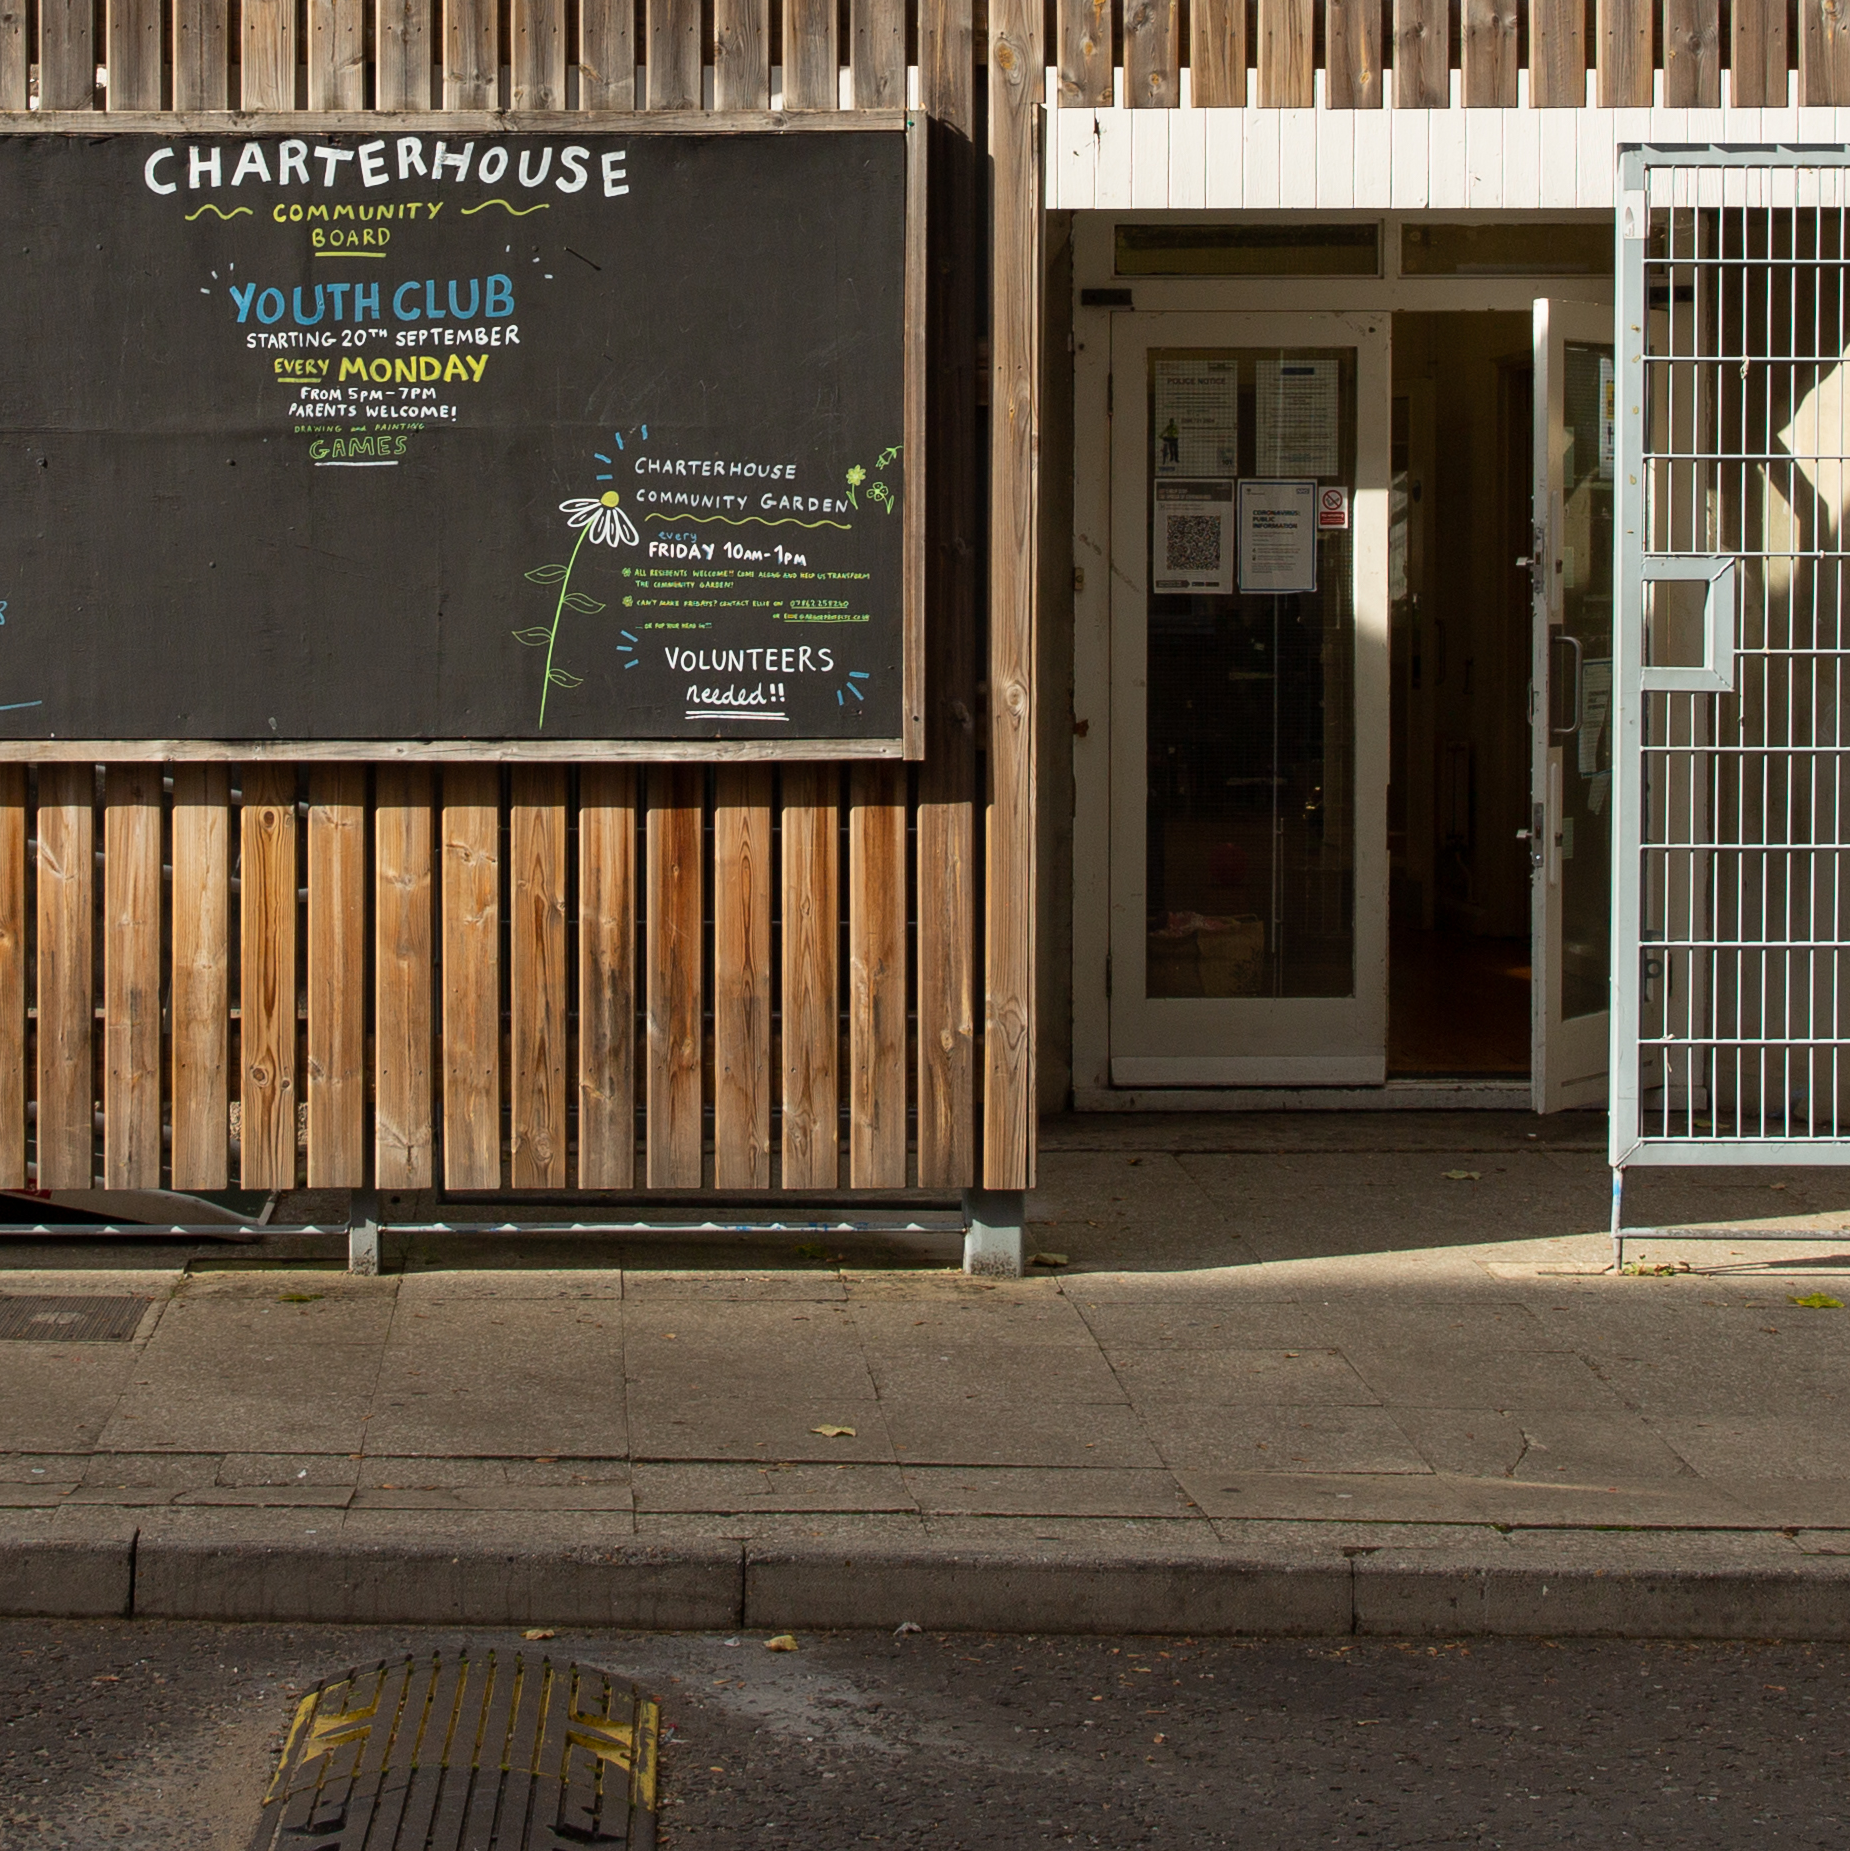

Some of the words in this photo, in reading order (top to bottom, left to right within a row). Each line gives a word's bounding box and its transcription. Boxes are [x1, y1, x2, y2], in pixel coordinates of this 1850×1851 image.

[144, 138, 630, 198] CHARTERHOUSE
[273, 202, 443, 222] COMMUNITY
[312, 228, 390, 247] BOARD
[230, 283, 379, 325] YOUTH
[393, 274, 514, 321] CLUB
[247, 331, 336, 349] STARTING
[396, 325, 520, 346] SEPTEMBER
[274, 358, 329, 375] EVERY
[339, 354, 488, 382] MONDAY
[301, 387, 341, 400] FROM
[289, 403, 356, 417] PARENTS
[366, 405, 456, 421] WELCOME!
[309, 436, 407, 459] GAMES
[635, 457, 796, 479] CHARTERHOUSE
[637, 490, 747, 509] COMMUNITY
[761, 494, 848, 512] GARDEN
[658, 531, 698, 541] every
[649, 543, 714, 559] FRIDAY
[634, 568, 646, 577] ALL
[650, 569, 688, 577] RESIDENTS
[635, 580, 649, 588] THE
[665, 646, 834, 672] VOLUNTEERS
